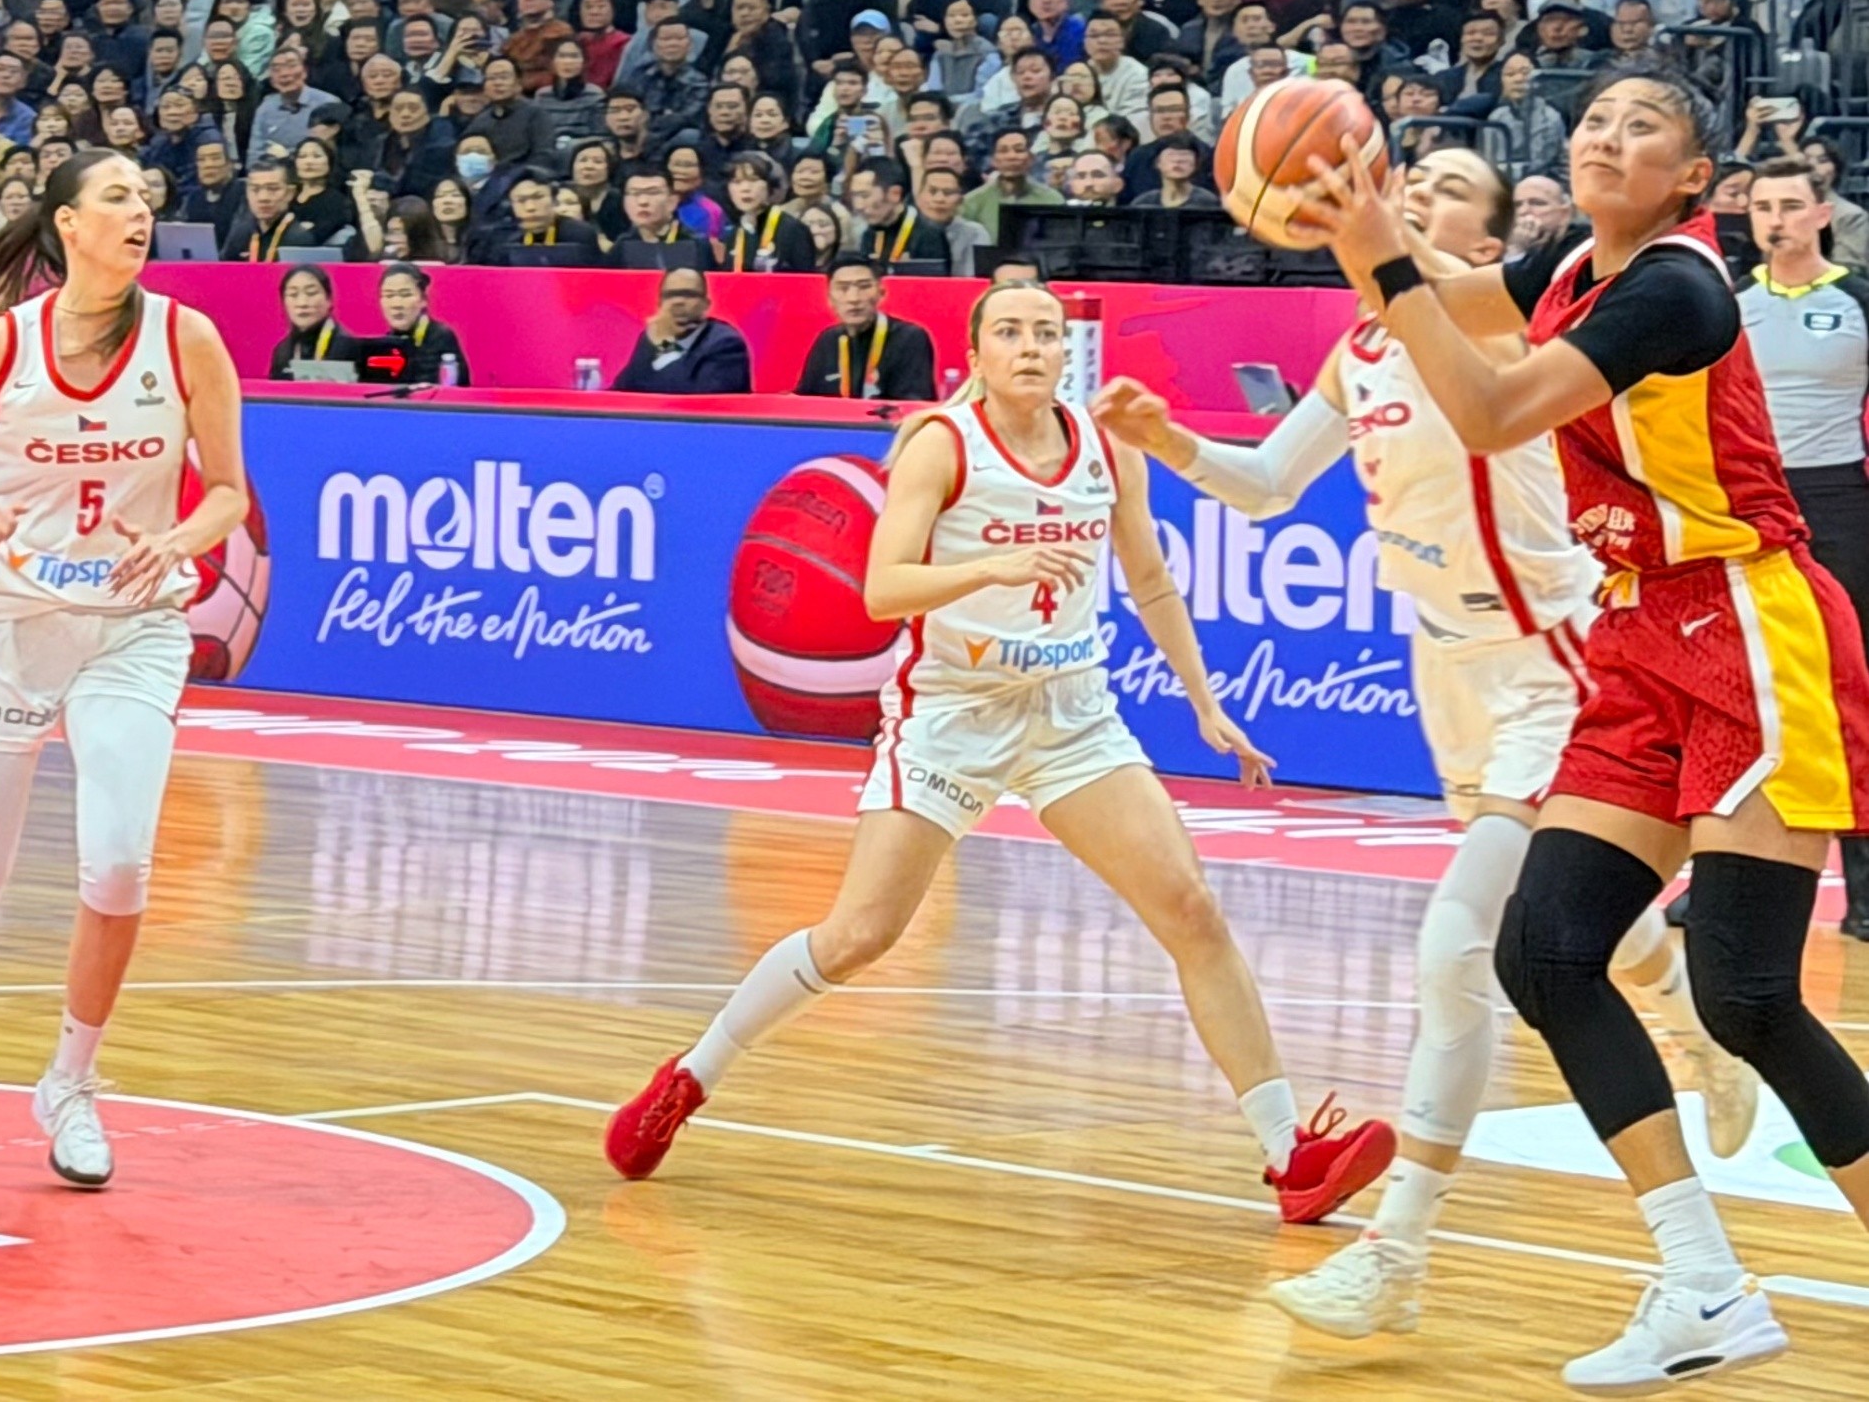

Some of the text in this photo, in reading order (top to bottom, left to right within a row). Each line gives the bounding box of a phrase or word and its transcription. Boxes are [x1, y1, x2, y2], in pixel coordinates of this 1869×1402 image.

[24, 436, 166, 465] ČESKO
[76, 479, 107, 537] 5
[318, 459, 656, 582] molten
[981, 517, 1107, 546] ČESKO
[35, 554, 115, 590] Tipsp
[317, 566, 414, 647] feel
[406, 586, 483, 640] the
[1030, 579, 1059, 625] 4
[998, 634, 1095, 674] Tipsport
